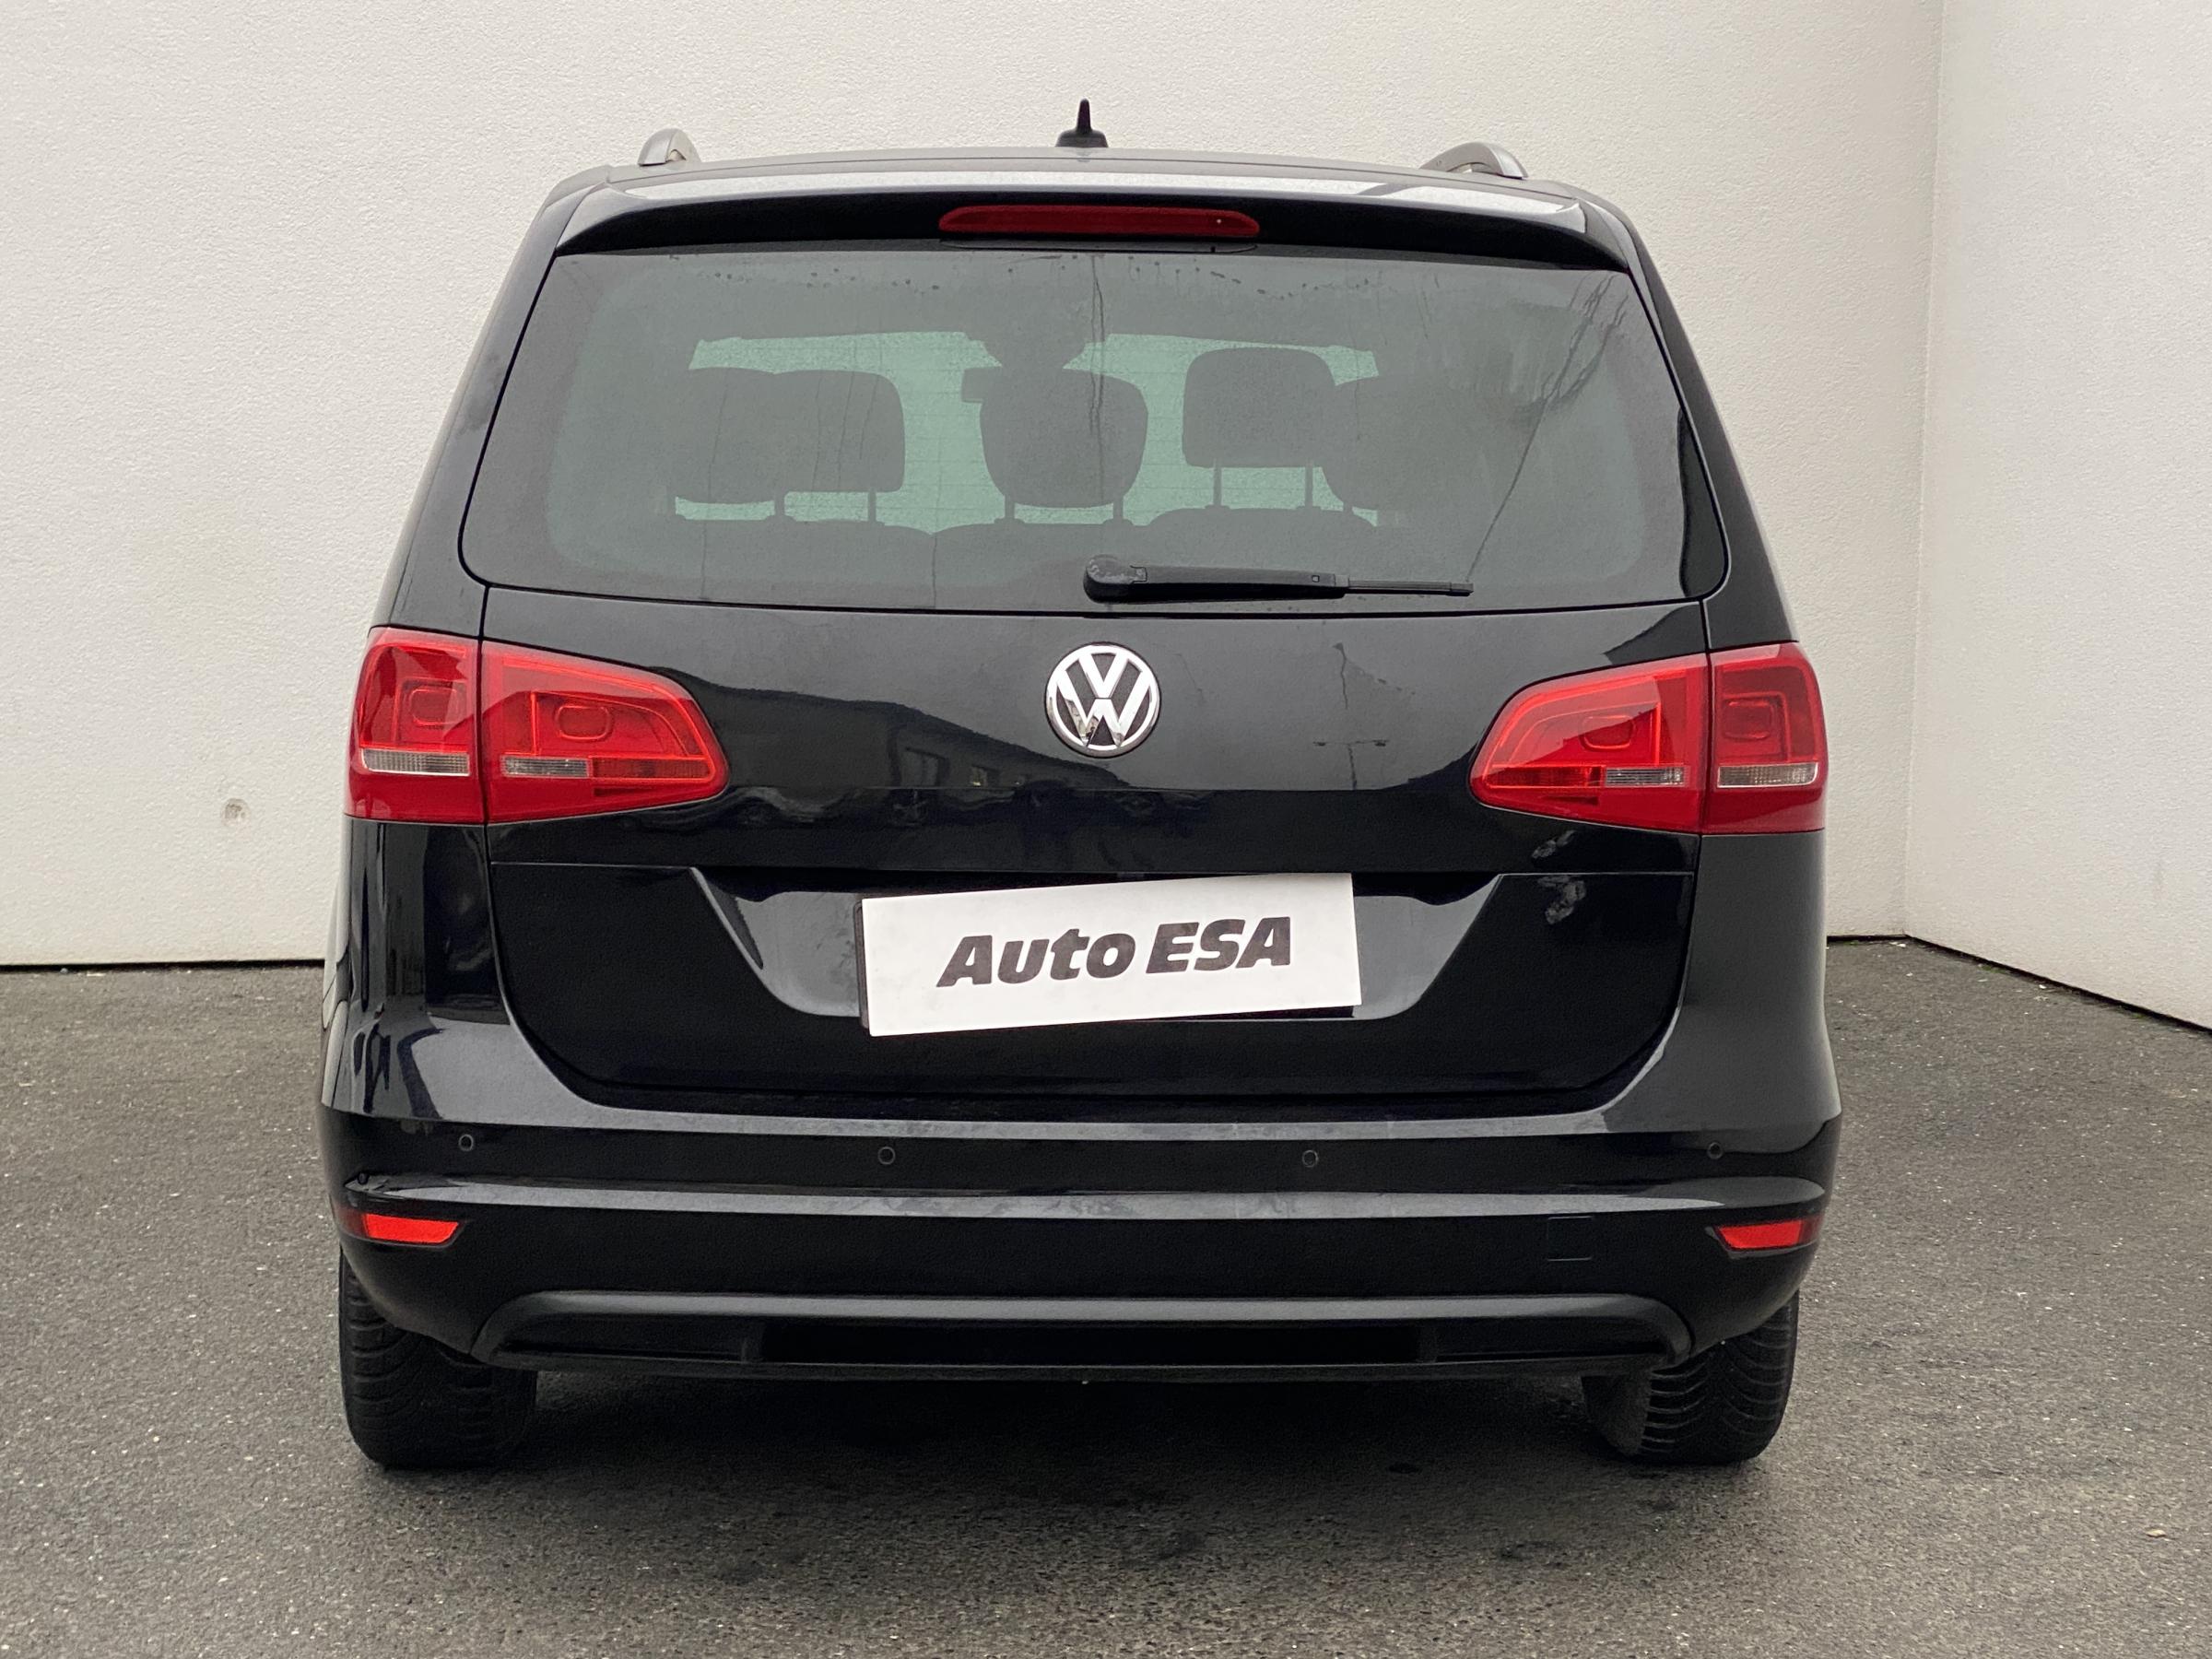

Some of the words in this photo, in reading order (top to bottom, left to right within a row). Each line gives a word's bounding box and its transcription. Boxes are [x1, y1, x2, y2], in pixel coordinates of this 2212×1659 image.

[1053, 648, 1153, 748] VW
[935, 928, 1135, 988] Auto
[1146, 916, 1291, 975] ESA
